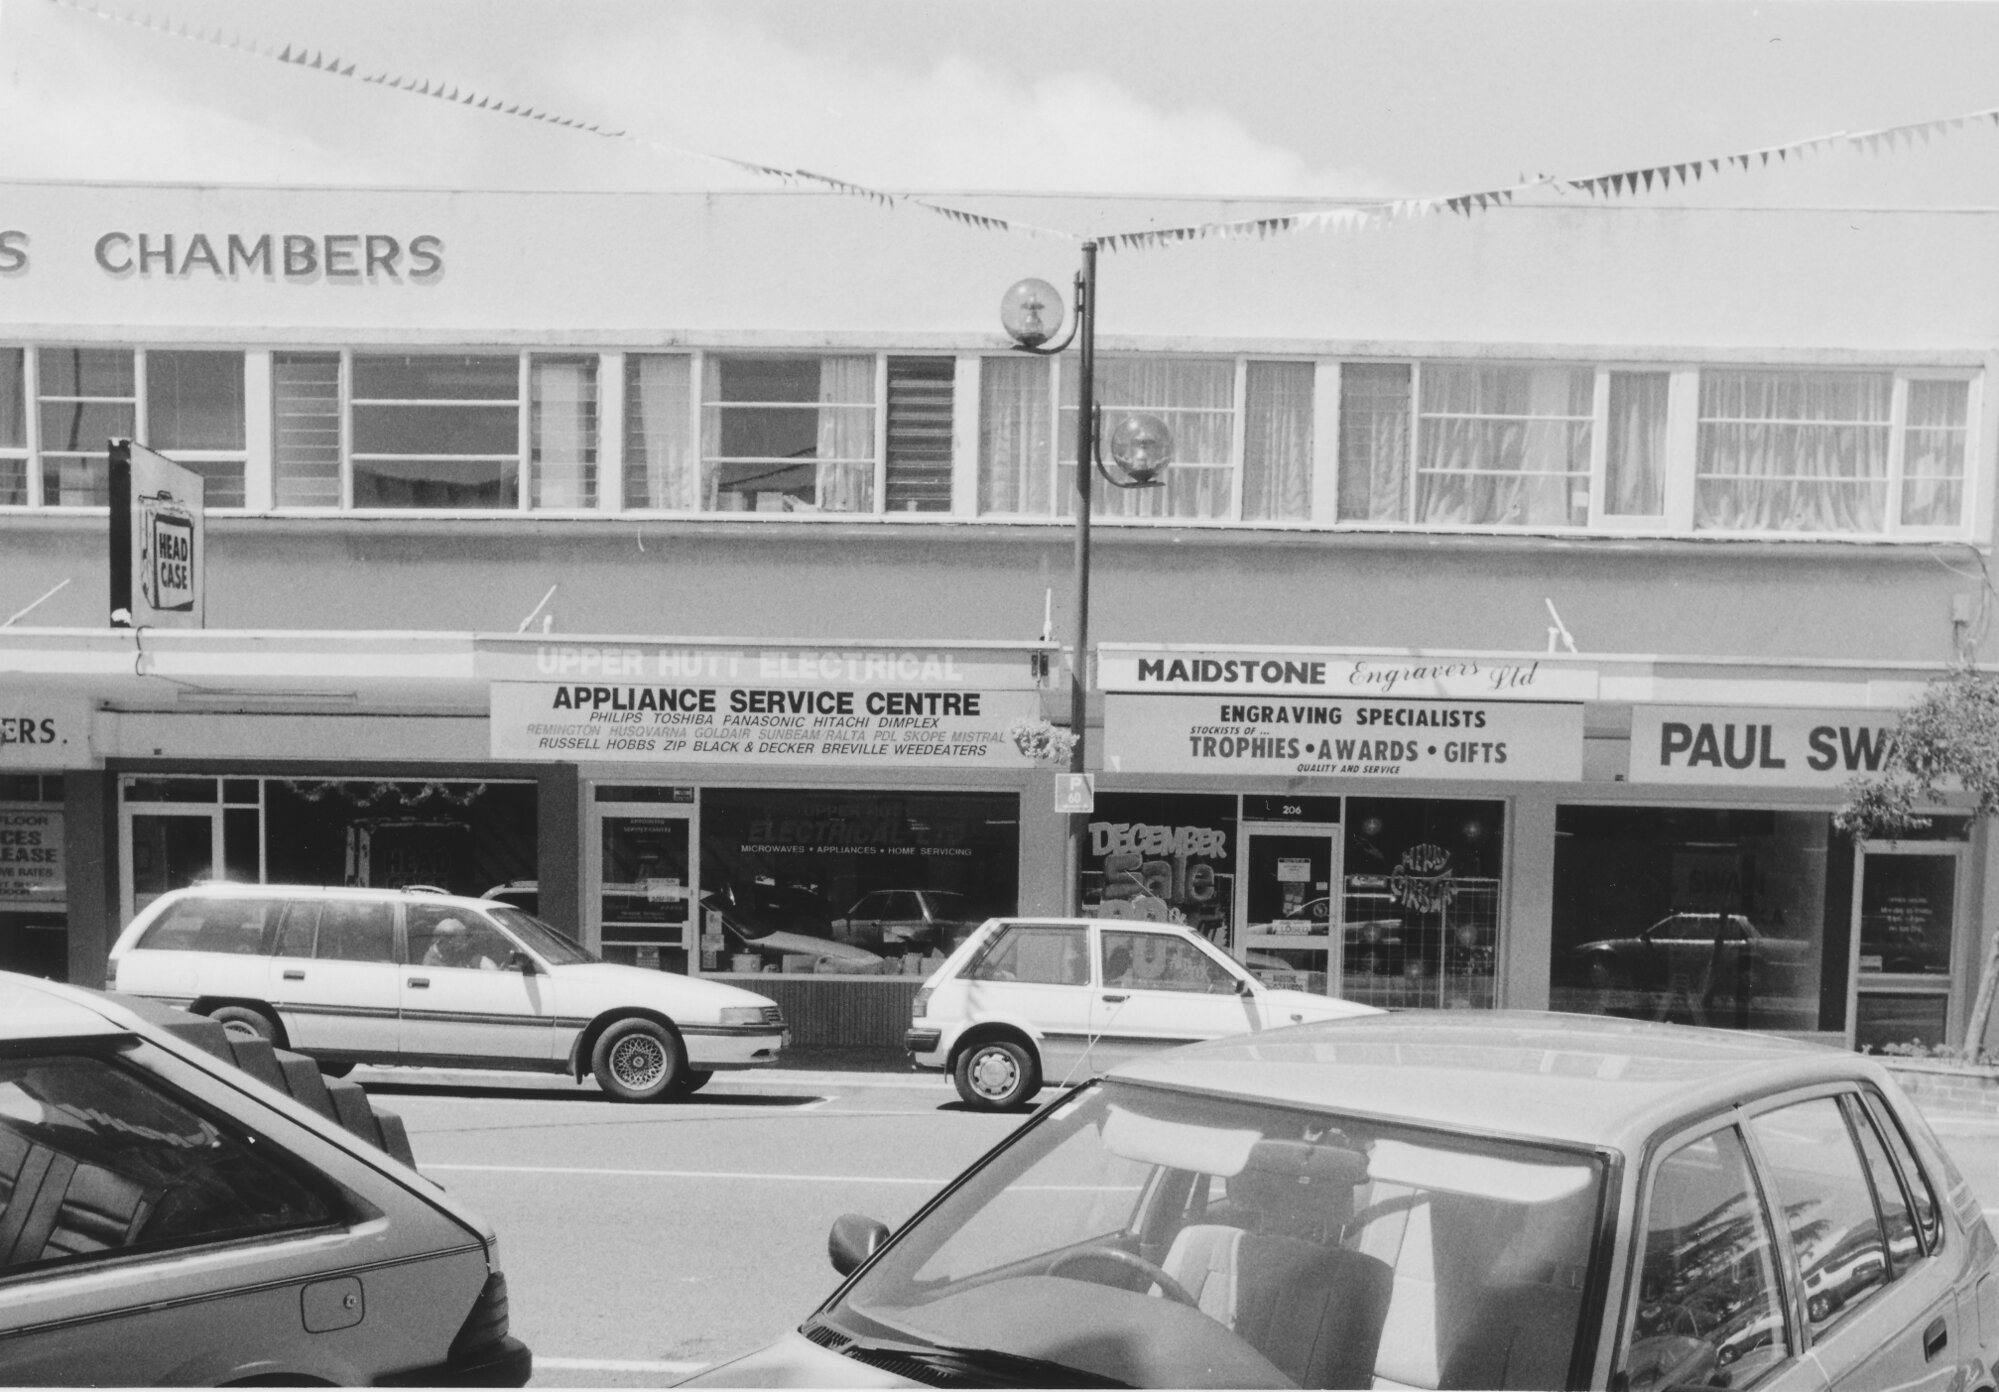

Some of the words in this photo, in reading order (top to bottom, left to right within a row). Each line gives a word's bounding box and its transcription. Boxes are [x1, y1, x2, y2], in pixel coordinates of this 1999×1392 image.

[94, 231, 445, 286] CHAMBERS
[159, 533, 188, 562] HEAD
[160, 562, 188, 590] CASE
[537, 646, 644, 677] UPPER
[658, 649, 740, 679] HUTT
[759, 652, 963, 684] ELECTRICAL
[1138, 658, 1327, 685] MAIDSTONE
[1349, 661, 1480, 693] Engravers
[1489, 661, 1540, 691] Ltd
[553, 686, 716, 713] APPLIANCE
[729, 689, 854, 714] SERVICE
[866, 692, 980, 716] CENTRE
[590, 712, 643, 723] PHILIPS
[653, 713, 713, 725] TOSHIBA
[723, 714, 806, 728] PANASONIC
[813, 716, 870, 728] HITACHI
[878, 717, 940, 729] DIMPLEX
[1220, 705, 1342, 725] ENGRAVING
[1356, 708, 1486, 728] SPECIALISTS
[527, 724, 602, 736] REMINGTON
[609, 726, 687, 739] HUSQVARNA
[694, 728, 752, 740] GOLDAIR
[758, 729, 820, 741] SUNBEAM
[825, 730, 866, 742] RALTA
[873, 731, 898, 742] PDL
[903, 731, 947, 743] SKOPE
[951, 732, 1007, 744] MISTRAL
[1190, 726, 1240, 736] STOCKISTS
[1244, 727, 1257, 736] OF
[538, 737, 601, 750] RUSSELL
[606, 739, 656, 751] HOBBS
[663, 740, 687, 752] ZIP
[693, 740, 739, 753] BLACK
[744, 741, 754, 753] &
[758, 742, 815, 754] DECKER
[821, 743, 889, 755] BREVILLE
[892, 744, 987, 756] WEEDEATERS
[1189, 736, 1300, 759] TROPHIES
[1317, 739, 1418, 761] AWARDS
[1444, 741, 1507, 764] GIFTS
[1660, 722, 1786, 770] PAUL
[1297, 763, 1337, 773] QUALITY
[1341, 765, 1360, 773] AND
[1363, 765, 1400, 774] SERVICE
[1070, 777, 1081, 791] P
[1283, 805, 1302, 815] 206
[741, 844, 805, 854] MICROWAVES
[816, 846, 877, 855] APPLIANCES
[888, 847, 916, 856] HOME
[920, 848, 972, 856] SERVICING
[1088, 821, 1228, 859] DECEMBER
[1104, 852, 1215, 904] Sale
